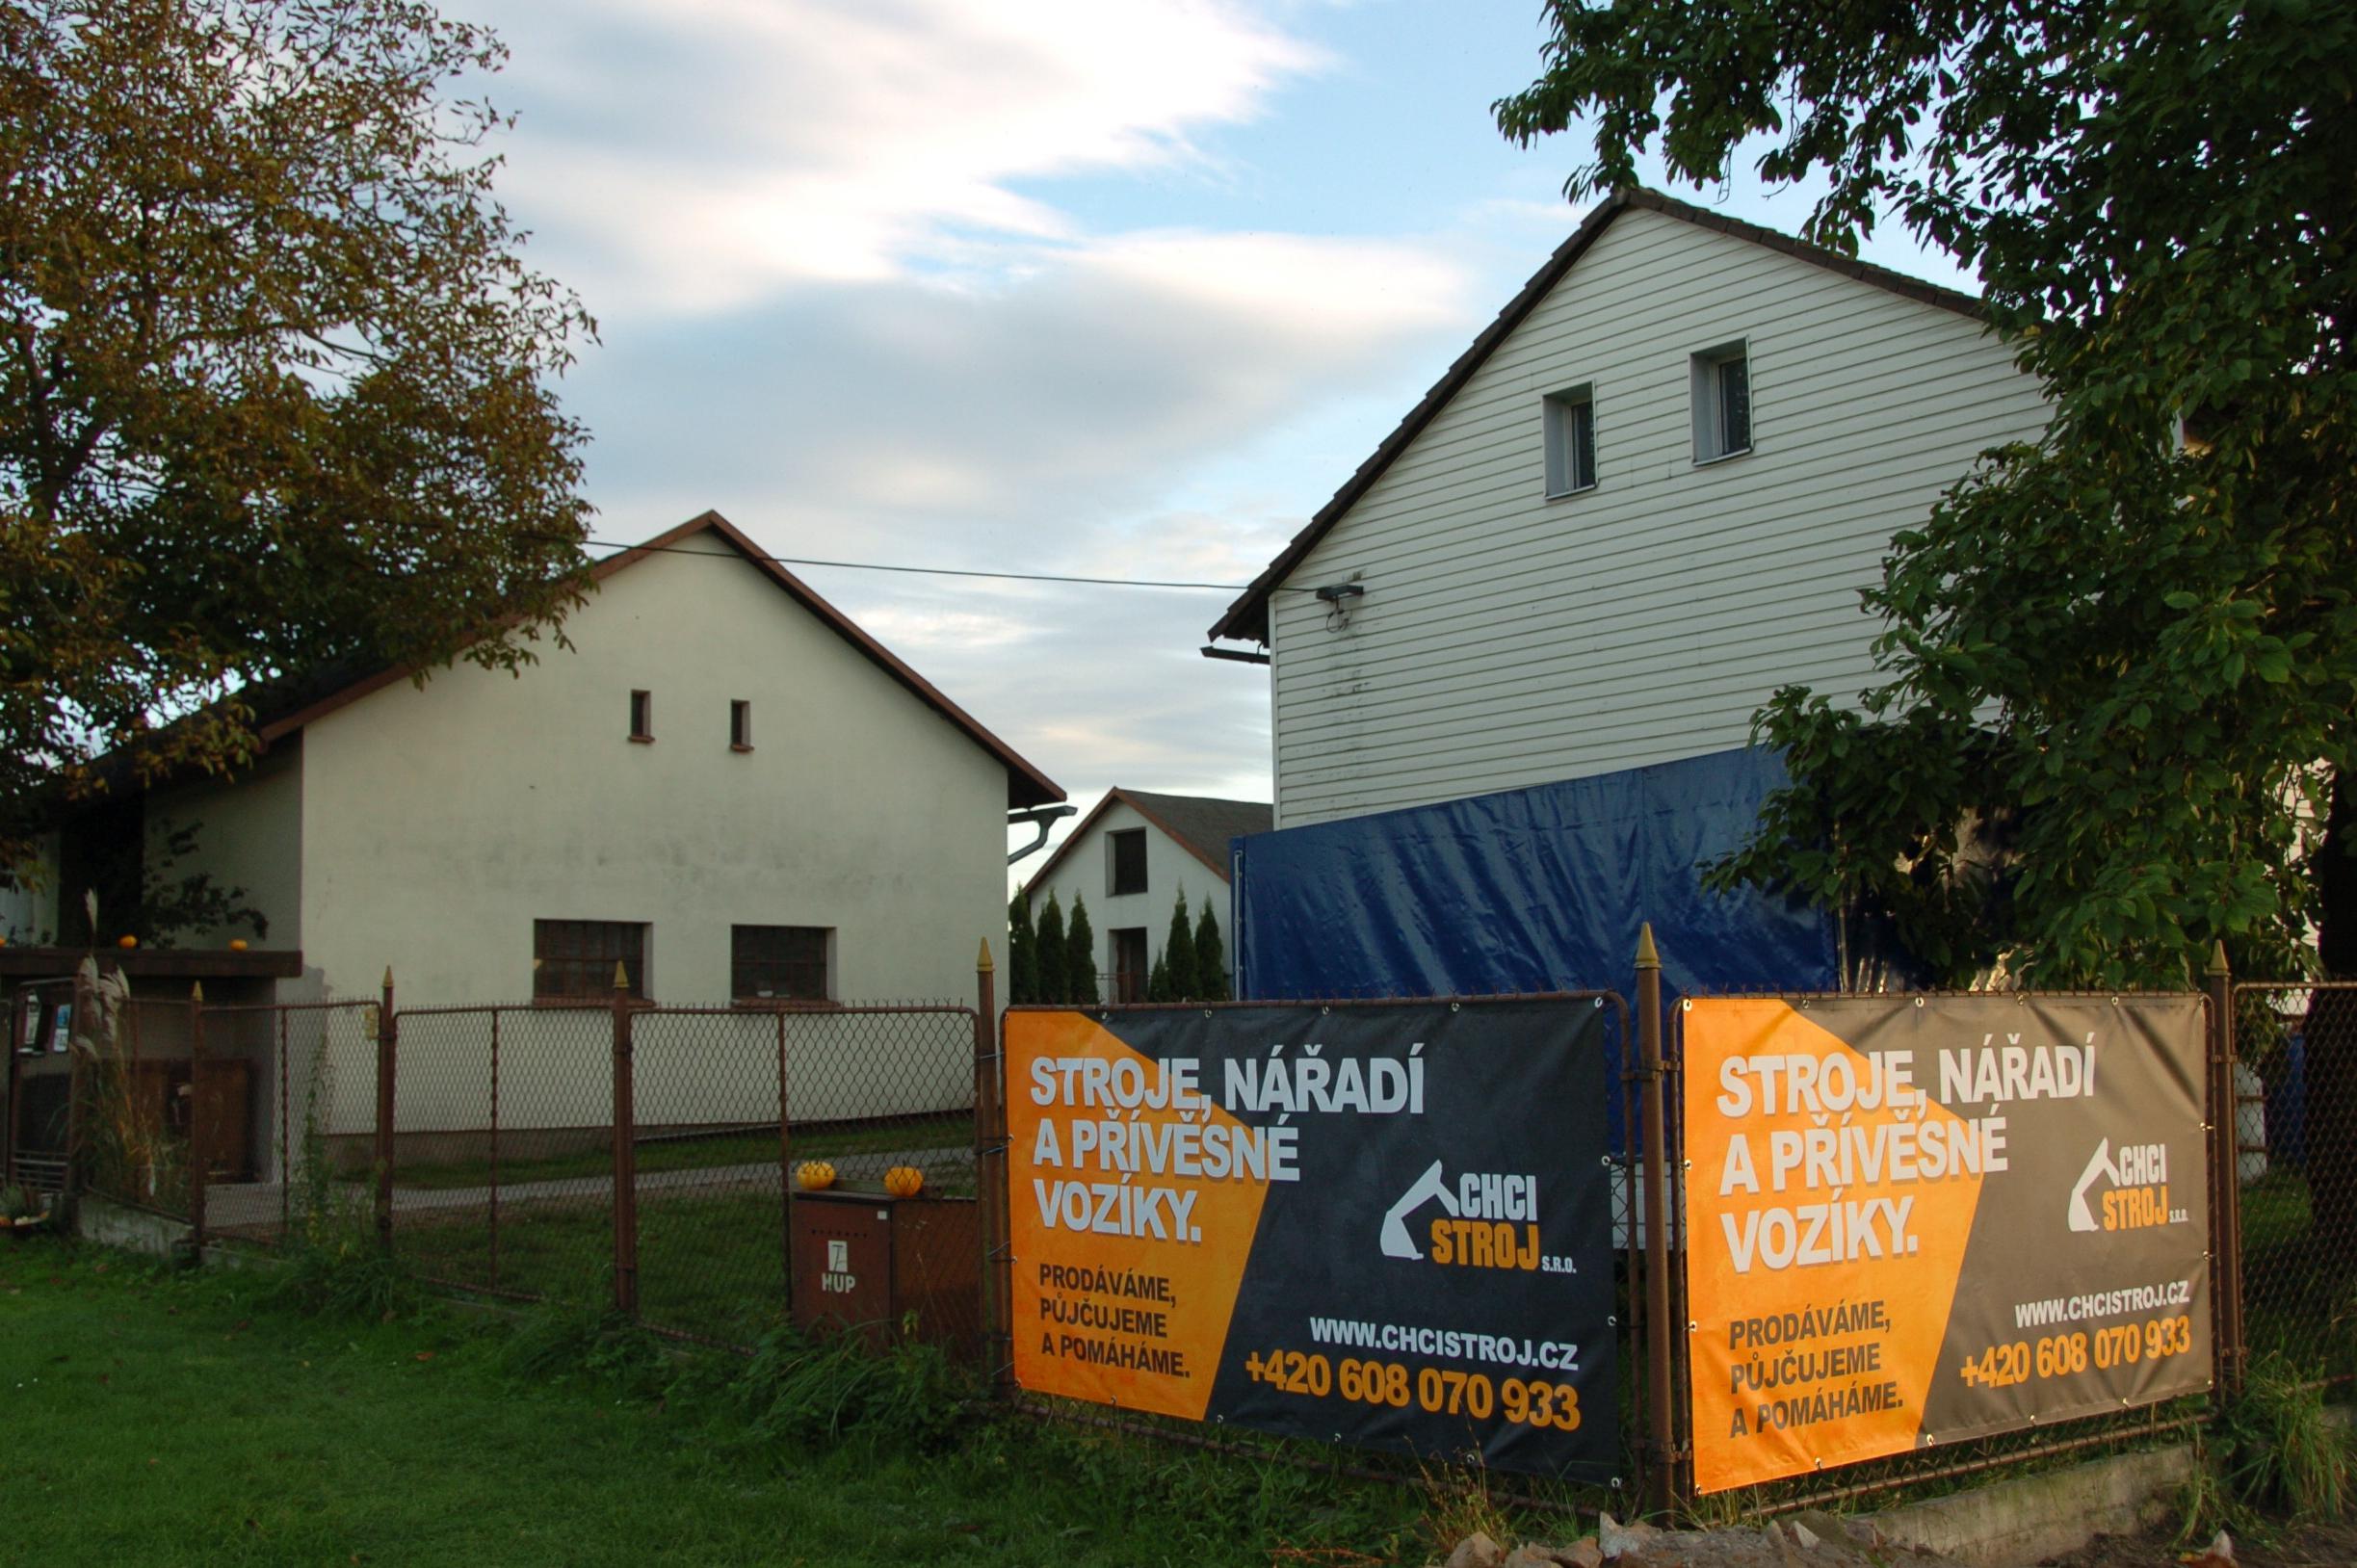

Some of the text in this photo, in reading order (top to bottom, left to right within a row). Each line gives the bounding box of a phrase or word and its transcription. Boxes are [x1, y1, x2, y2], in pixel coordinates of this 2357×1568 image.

[1031, 1043, 1425, 1122] STROJE, NÁŘADÍ
[1716, 1032, 2096, 1118] STROJE, NÁŘADÍ
[1033, 1107, 1300, 1182] A PŘÍVĚSNÉ
[1718, 1103, 2008, 1196] A PŘÍVĚSNÉ
[2118, 1143, 2167, 1187] CHCI
[1033, 1172, 1202, 1243] VOZÍKY.
[1458, 1172, 1537, 1222] CHCI
[2102, 1185, 2168, 1232] STROJ
[1431, 1219, 1578, 1274] STROJ S.R.O.
[1719, 1187, 1919, 1274] VOZÍKY.
[821, 1272, 856, 1294] HUP
[1038, 1263, 1177, 1308] PRODÁVÁME,
[2014, 1280, 2190, 1329] WWW.CHCISTROJ.CZ
[1039, 1293, 1167, 1338] PŮJČUJEME
[1730, 1298, 1891, 1350] PRODÁVÁME,
[1041, 1333, 1191, 1378] A POMÁHÁME.
[1310, 1317, 1579, 1372] WWW.CHCISTROJ.CZ
[1731, 1342, 1881, 1395] PŮJČUJEME
[1960, 1315, 2191, 1389] +420 608 070 933
[1245, 1349, 1582, 1431] +420 608 070 933
[1730, 1380, 1904, 1438] A POMÁHÁME.
